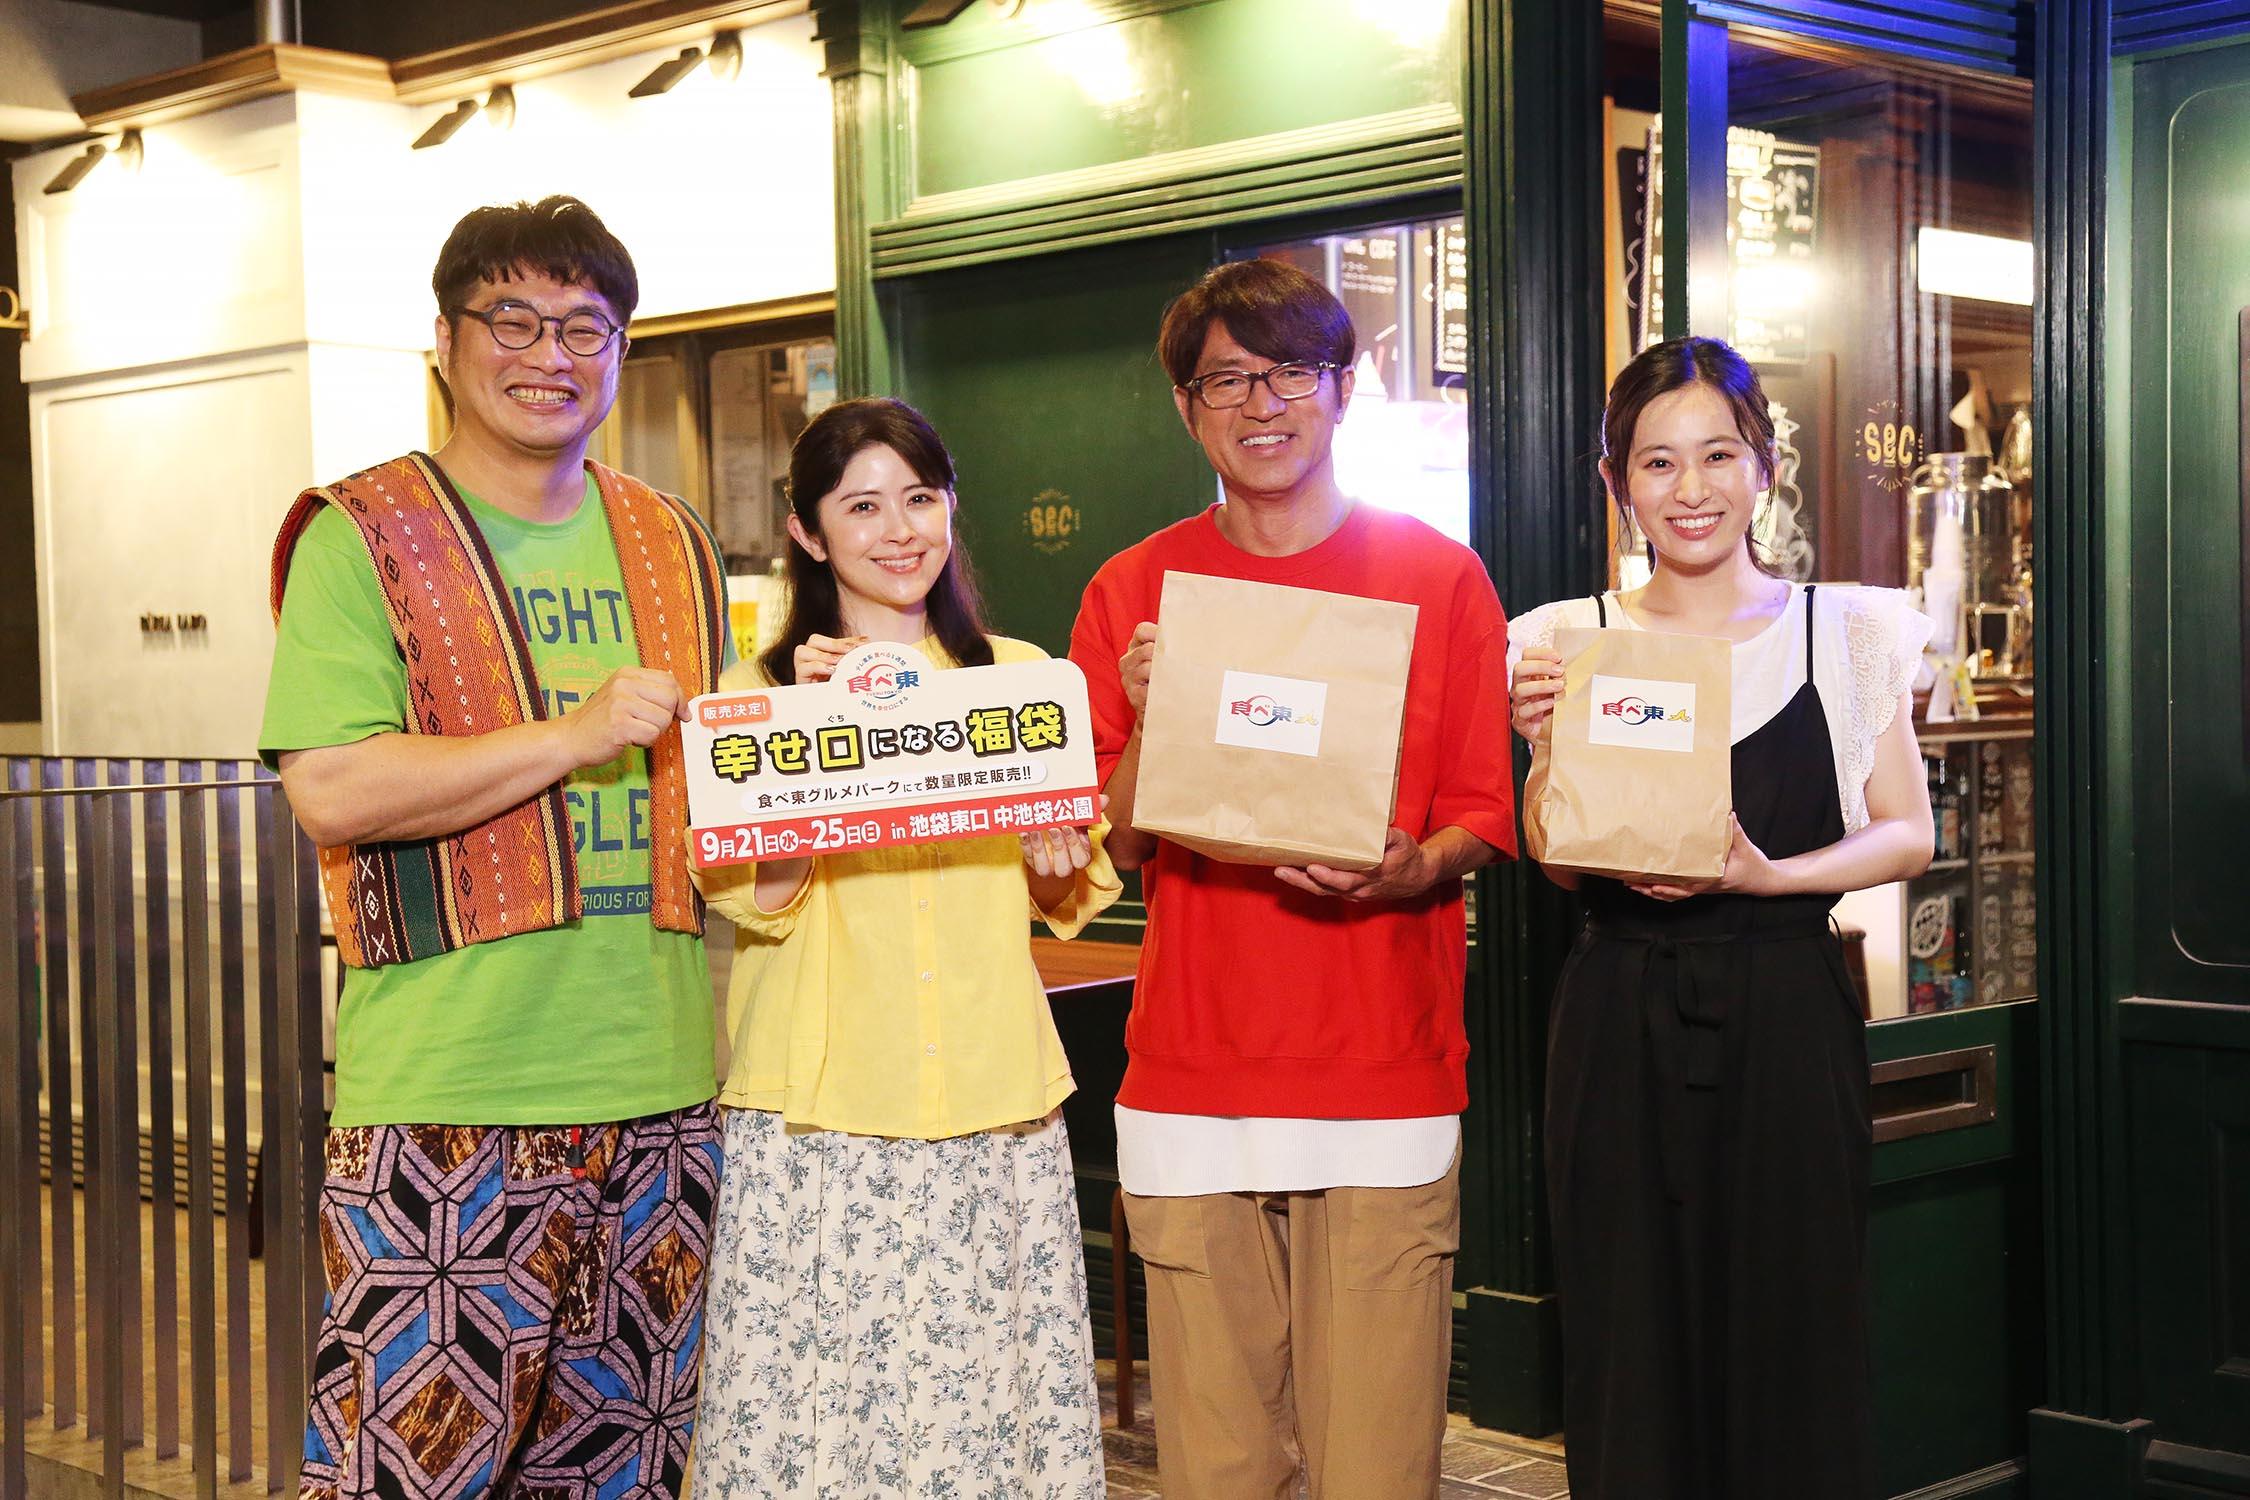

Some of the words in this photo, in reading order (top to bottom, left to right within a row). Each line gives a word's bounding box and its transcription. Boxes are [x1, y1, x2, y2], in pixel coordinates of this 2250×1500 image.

[847, 671, 919, 694] 食べ東
[703, 702, 767, 721] 販売決定!
[827, 714, 845, 723] ぐち
[1231, 700, 1292, 722] 食べ東
[1602, 703, 1664, 720] 食べ東
[711, 701, 1068, 783] 幸せ口になる福袋
[891, 823, 907, 840] in
[909, 808, 990, 838] 池袋東口
[994, 796, 1094, 829] 中池袋公園
